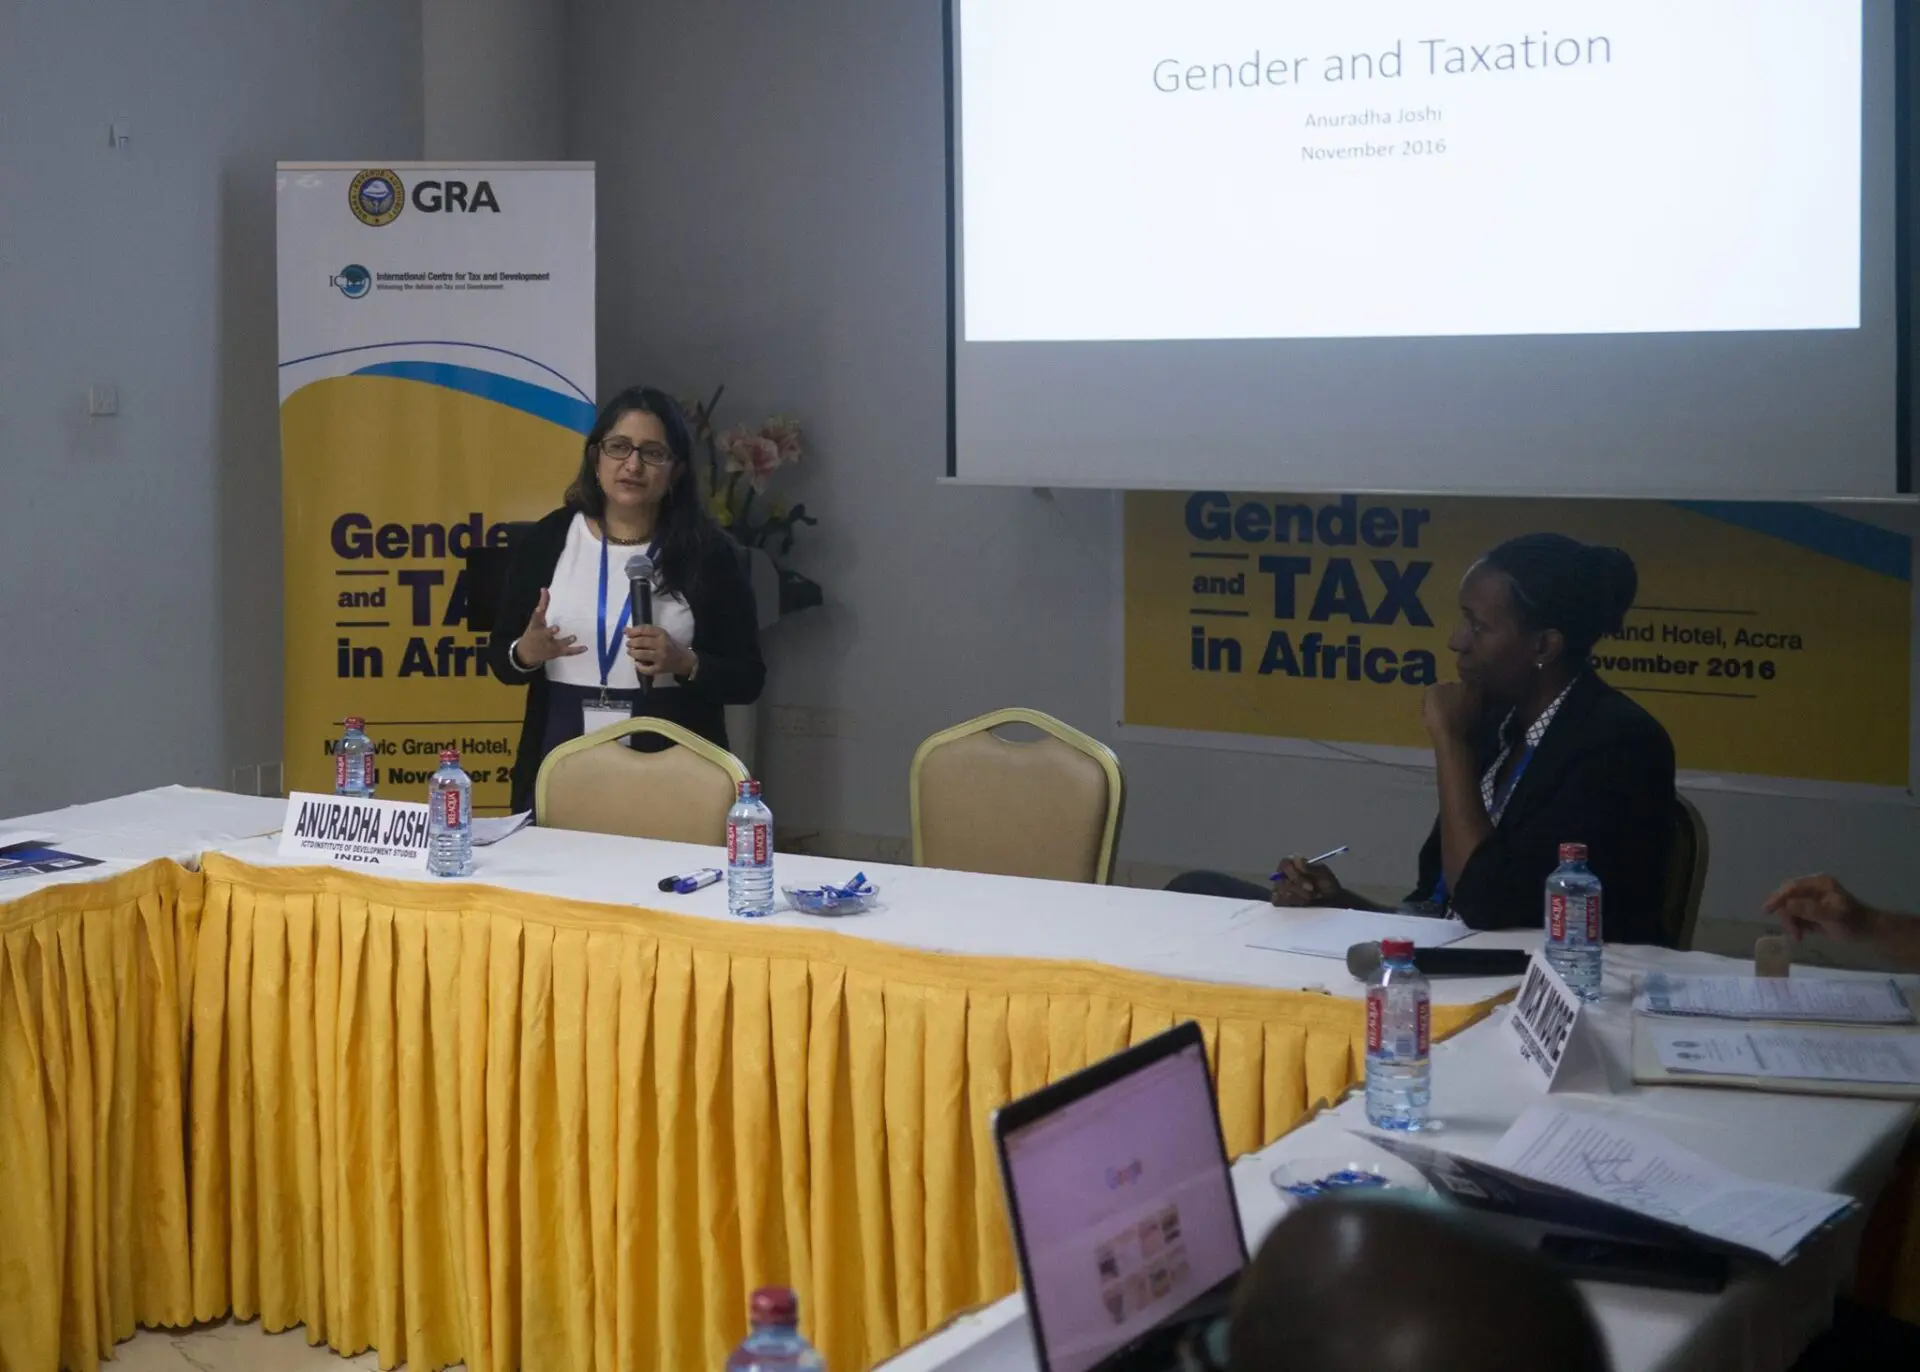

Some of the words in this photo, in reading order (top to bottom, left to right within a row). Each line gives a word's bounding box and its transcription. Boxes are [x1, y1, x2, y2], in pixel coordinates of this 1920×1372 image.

[1153, 49, 1309, 92] Gender
[1324, 38, 1402, 82] and
[1418, 30, 1612, 75] Taxation
[1304, 108, 1392, 128] Anuradha
[1396, 105, 1443, 124] Joshi
[1301, 141, 1395, 161] November
[1402, 138, 1447, 157] 2016
[412, 180, 501, 213] GRA
[376, 271, 425, 281] International
[428, 271, 453, 281] Centre
[455, 271, 466, 281] for
[467, 271, 481, 281] Tax
[483, 271, 497, 281] and
[499, 271, 550, 283] Development
[1185, 491, 1431, 549] Gender
[331, 512, 509, 560] Gende
[338, 588, 386, 608] and
[1192, 573, 1245, 596] and
[1259, 555, 1435, 628] TAX
[1661, 624, 1728, 649] Hotel,
[1734, 628, 1803, 650] Accra
[338, 638, 383, 677] in
[1191, 625, 1242, 673] in
[1258, 630, 1438, 685] Africa
[1590, 653, 1699, 675] ovember
[1707, 658, 1776, 680] 2016
[402, 737, 457, 755] Grand
[462, 737, 512, 756] Hotel,
[294, 801, 381, 843] ANURADHA
[335, 853, 380, 864] INDIA
[344, 844, 352, 852] OF
[353, 845, 393, 856] DEVELOPMENT
[393, 848, 417, 859] STUDIES
